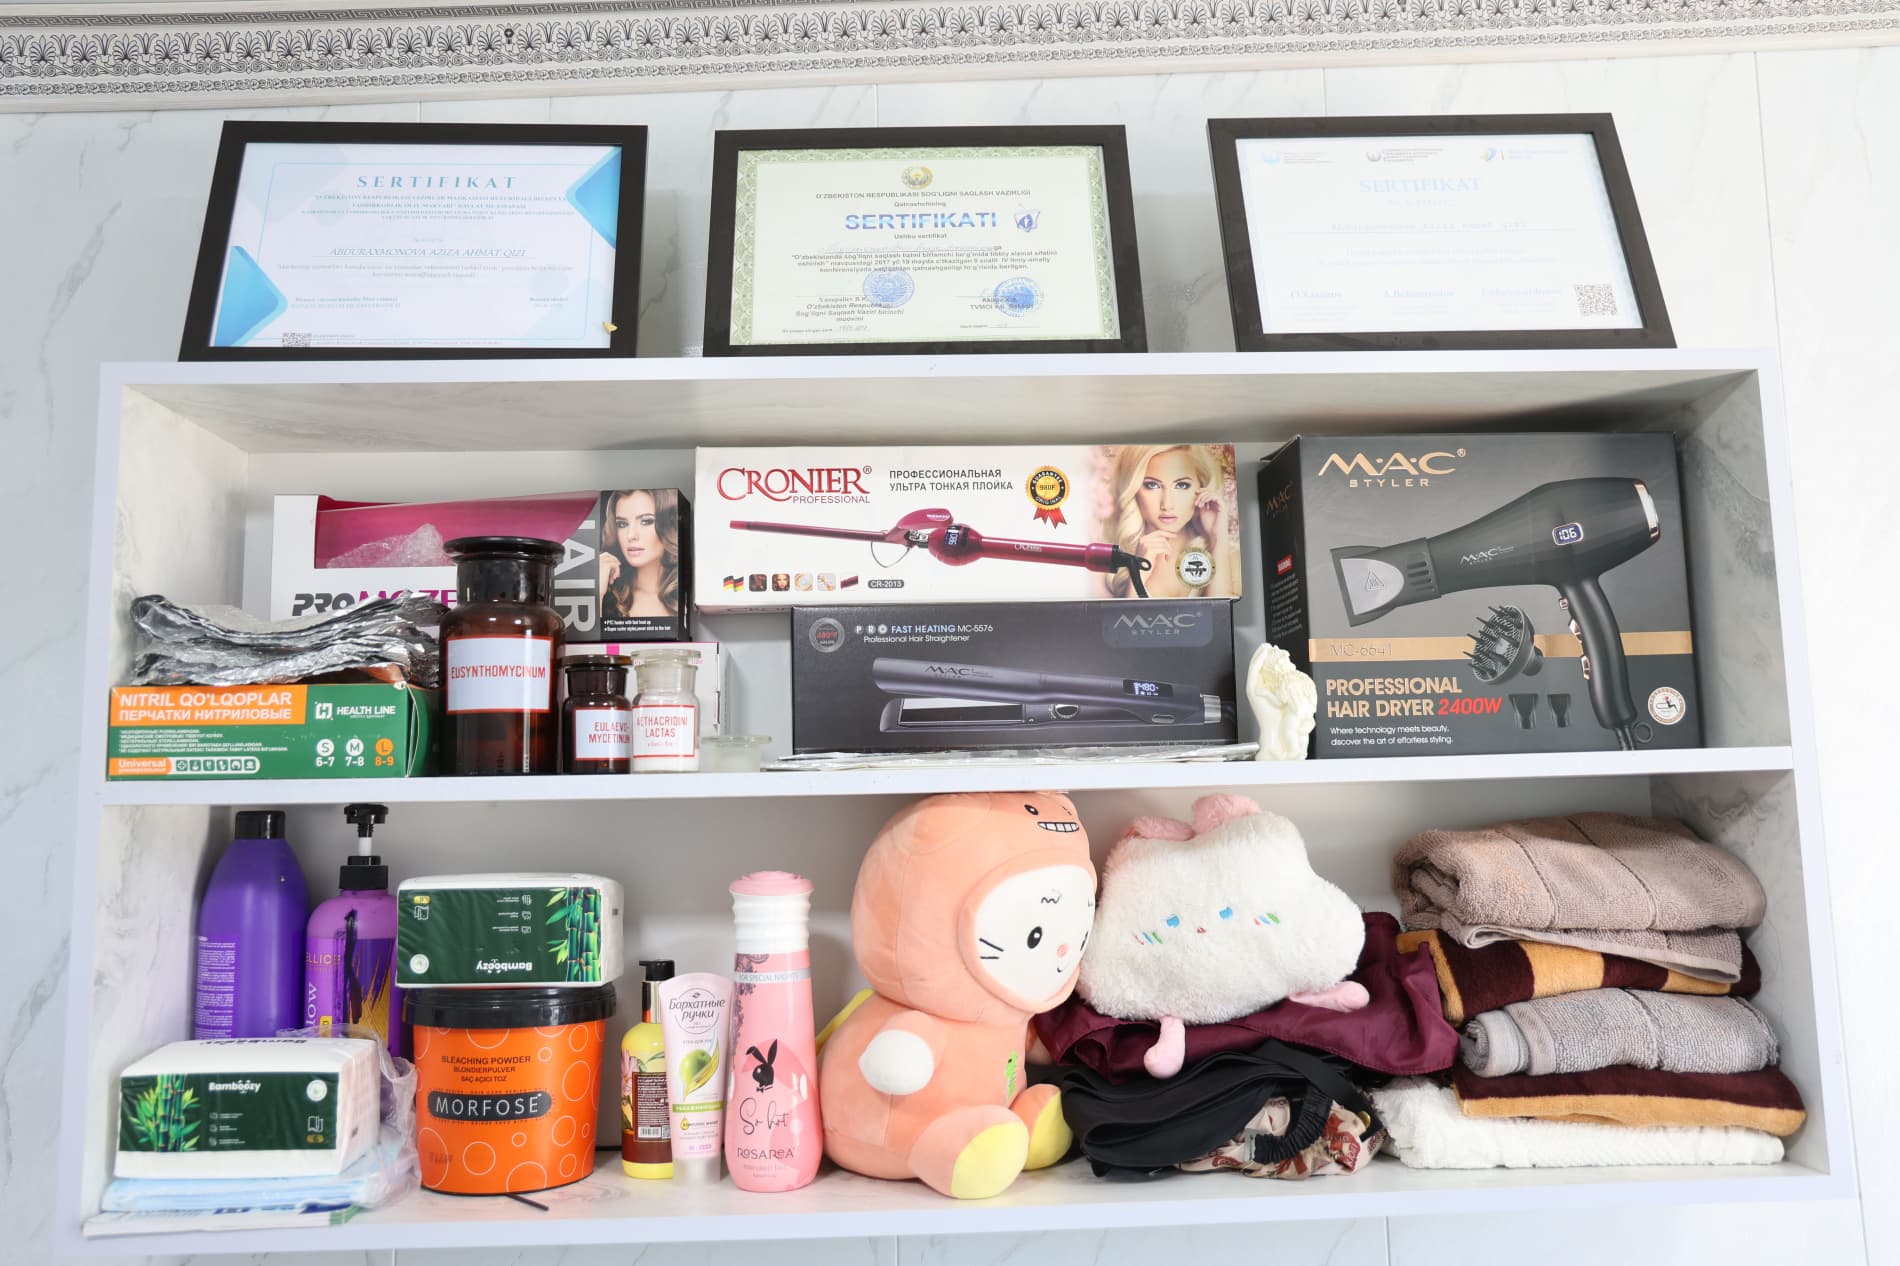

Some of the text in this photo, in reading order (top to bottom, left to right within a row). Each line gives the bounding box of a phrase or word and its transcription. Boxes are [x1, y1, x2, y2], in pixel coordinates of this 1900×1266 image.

[357, 175, 517, 189] SERTIFIKAT
[1359, 177, 1481, 193] SERTIFIKAT
[845, 211, 997, 230] SERTIFIKATI
[430, 248, 460, 257] AZIZA
[889, 469, 1002, 480] ПРОФЕССИОНАЛЬНАЯ
[717, 466, 871, 501] CRONIER
[889, 479, 1014, 492] УЛЬТРА ТОНКАЯ ПЛОЙКА
[1349, 479, 1431, 488] STYLER
[792, 494, 870, 504] PROFESSIONAL
[551, 519, 596, 632] AIR
[870, 580, 902, 588] CR-2013
[891, 625, 912, 633] FAST
[915, 625, 956, 633] HEATING
[957, 624, 994, 633] MC-5576
[863, 634, 970, 643] Professional Hair Straightener
[451, 664, 546, 679] EUSYNTHOMYCINUM
[1326, 676, 1463, 696] PROFESSIONAL
[120, 692, 292, 707] NITRIL QO'LQOPLAR
[336, 705, 372, 715] HEALTH
[374, 705, 397, 715] LINE
[1327, 697, 1503, 718] HAIR DRYER 2400W
[119, 708, 292, 721] ПЕРЧАТКИ НИТРИЛОВЫЕ
[636, 716, 688, 727] AETHACRIDINI
[645, 728, 676, 738] LACTAS
[1330, 727, 1353, 735] Where
[1354, 727, 1396, 736] technology
[1331, 738, 1361, 746] discover
[1363, 737, 1375, 745] the
[1376, 737, 1387, 745] art
[1397, 736, 1428, 744] effortless
[321, 742, 388, 753] S M L
[119, 759, 167, 769] Universal
[315, 756, 394, 767] 6-7 7-8 8-9
[750, 973, 773, 981] SPECIAL
[669, 998, 726, 1012] Бархатные
[682, 1009, 715, 1023] ручки
[441, 1055, 531, 1065] BLEACHING POWDER
[454, 1065, 516, 1073] BLONDIERPULVER
[436, 1096, 538, 1117] MORFOSE
[739, 1097, 763, 1135] So
